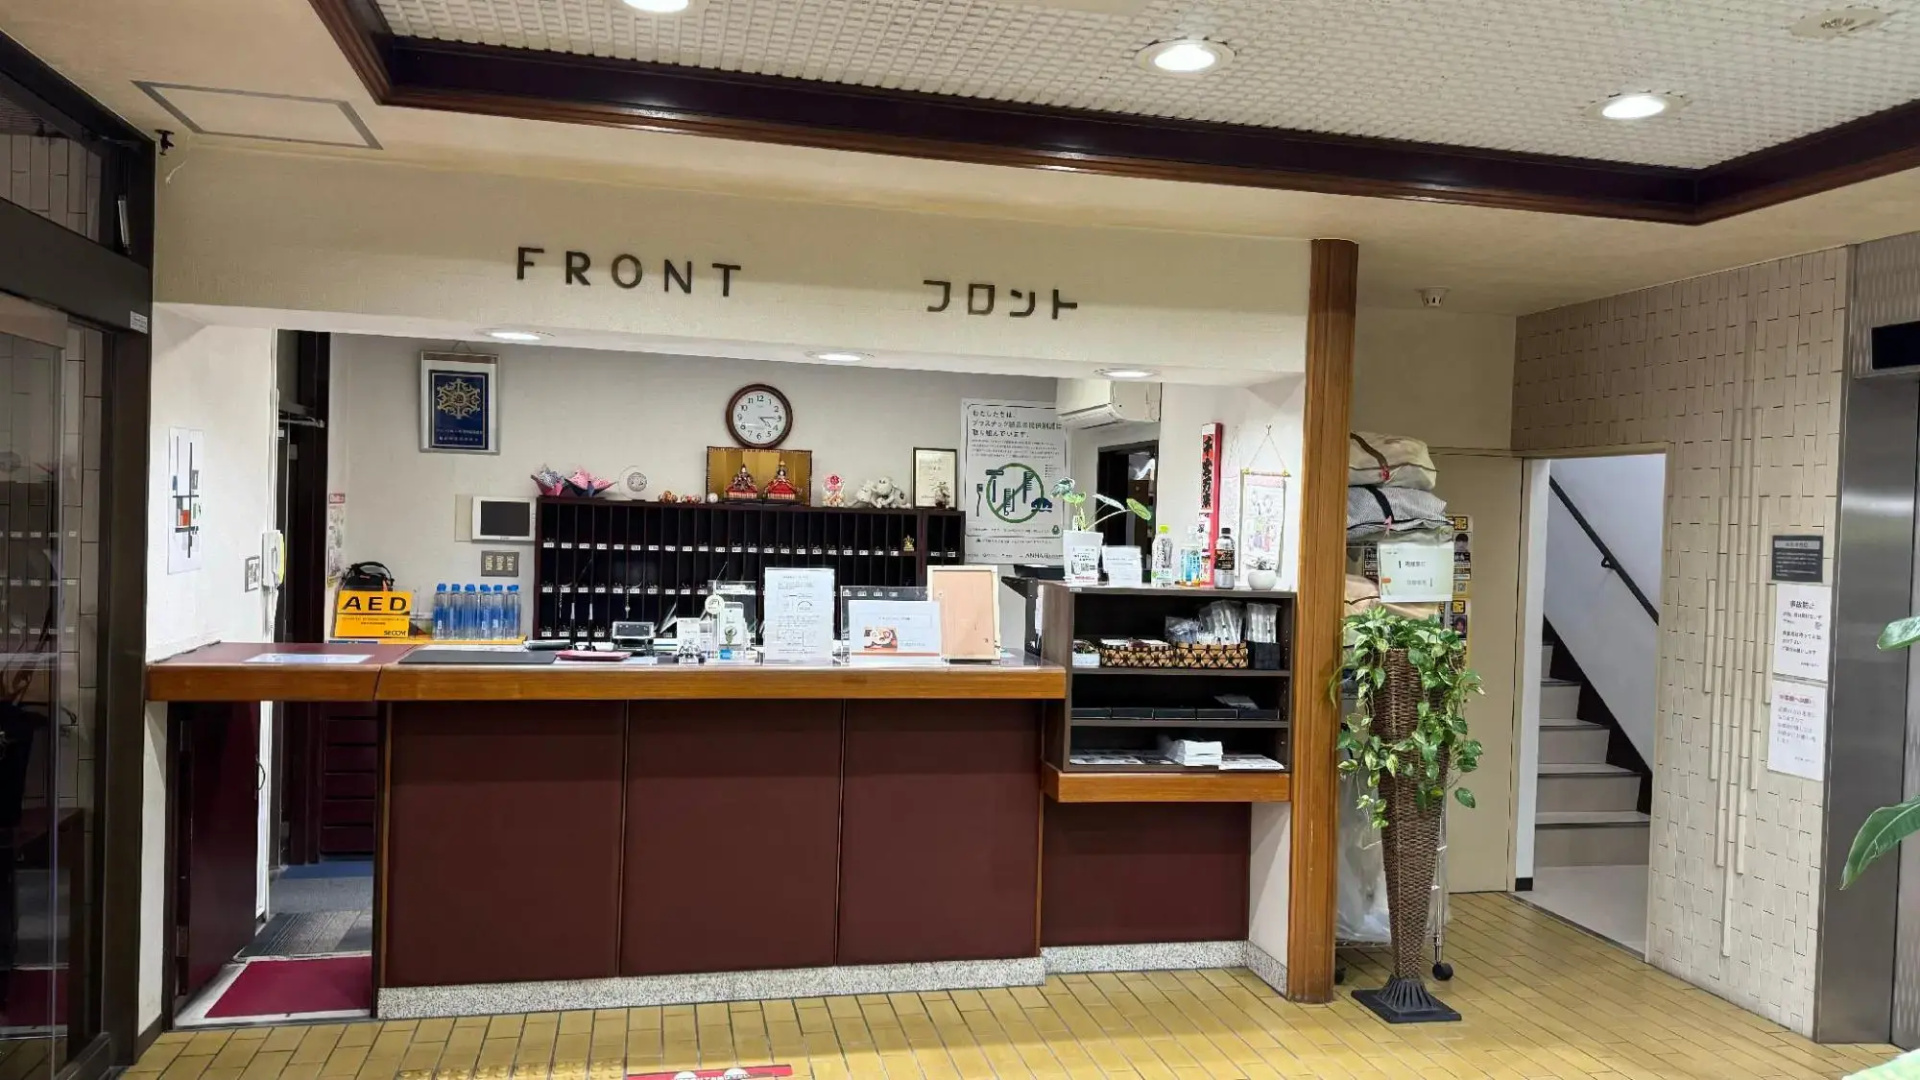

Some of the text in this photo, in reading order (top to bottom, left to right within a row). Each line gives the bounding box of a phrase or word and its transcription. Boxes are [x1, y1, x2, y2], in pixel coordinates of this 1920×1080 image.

[516, 247, 741, 297] FRONT
[923, 280, 1078, 320] フロント
[342, 596, 407, 611] AED
